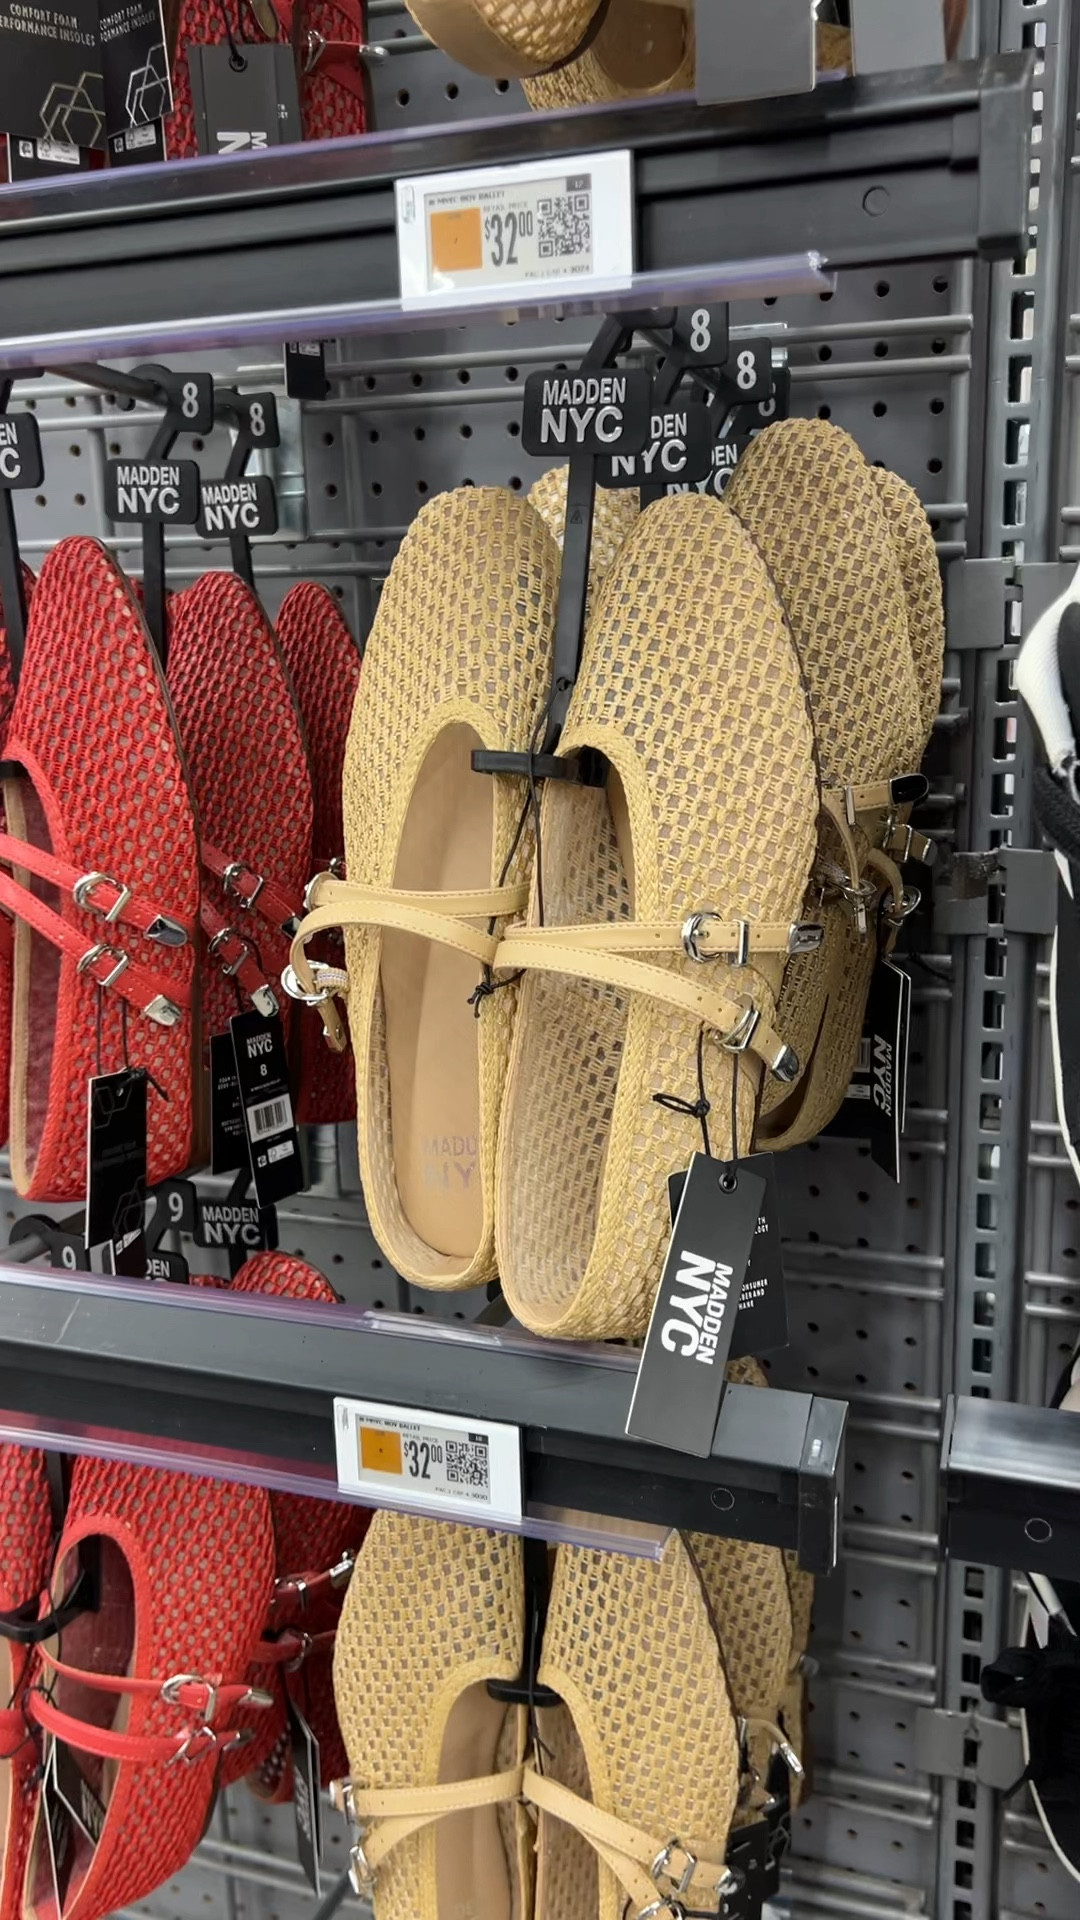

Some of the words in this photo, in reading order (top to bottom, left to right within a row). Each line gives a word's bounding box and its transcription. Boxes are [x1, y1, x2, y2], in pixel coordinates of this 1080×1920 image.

[9, 3, 50, 21] COMFORT
[53, 12, 78, 29] FOAM
[0, 14, 58, 40] ERFORMANCE
[59, 29, 96, 47] INSOLES
[690, 308, 711, 352] 8
[736, 350, 757, 389] 8
[182, 382, 199, 418] 8
[543, 377, 626, 406] MADDEN
[250, 402, 266, 436] 8
[540, 405, 623, 443] NYC
[651, 412, 687, 439] DEN
[117, 466, 180, 486] MADDEN
[118, 486, 180, 514] NYC
[202, 483, 257, 505] MADDEN
[204, 503, 260, 531] NYC
[248, 1038, 273, 1058] NYC
[260, 1063, 268, 1076] 8
[873, 1034, 888, 1110] NYC
[885, 1043, 893, 1117] MADDEN
[423, 1135, 477, 1156] MADD
[169, 1192, 183, 1222] 9
[203, 1205, 259, 1223] MADDEN
[204, 1222, 262, 1244] NYC
[62, 1246, 76, 1270] 9
[742, 1279, 768, 1292] ONSUMER
[661, 1250, 716, 1357] NYC
[695, 1262, 733, 1365] MADDEN
